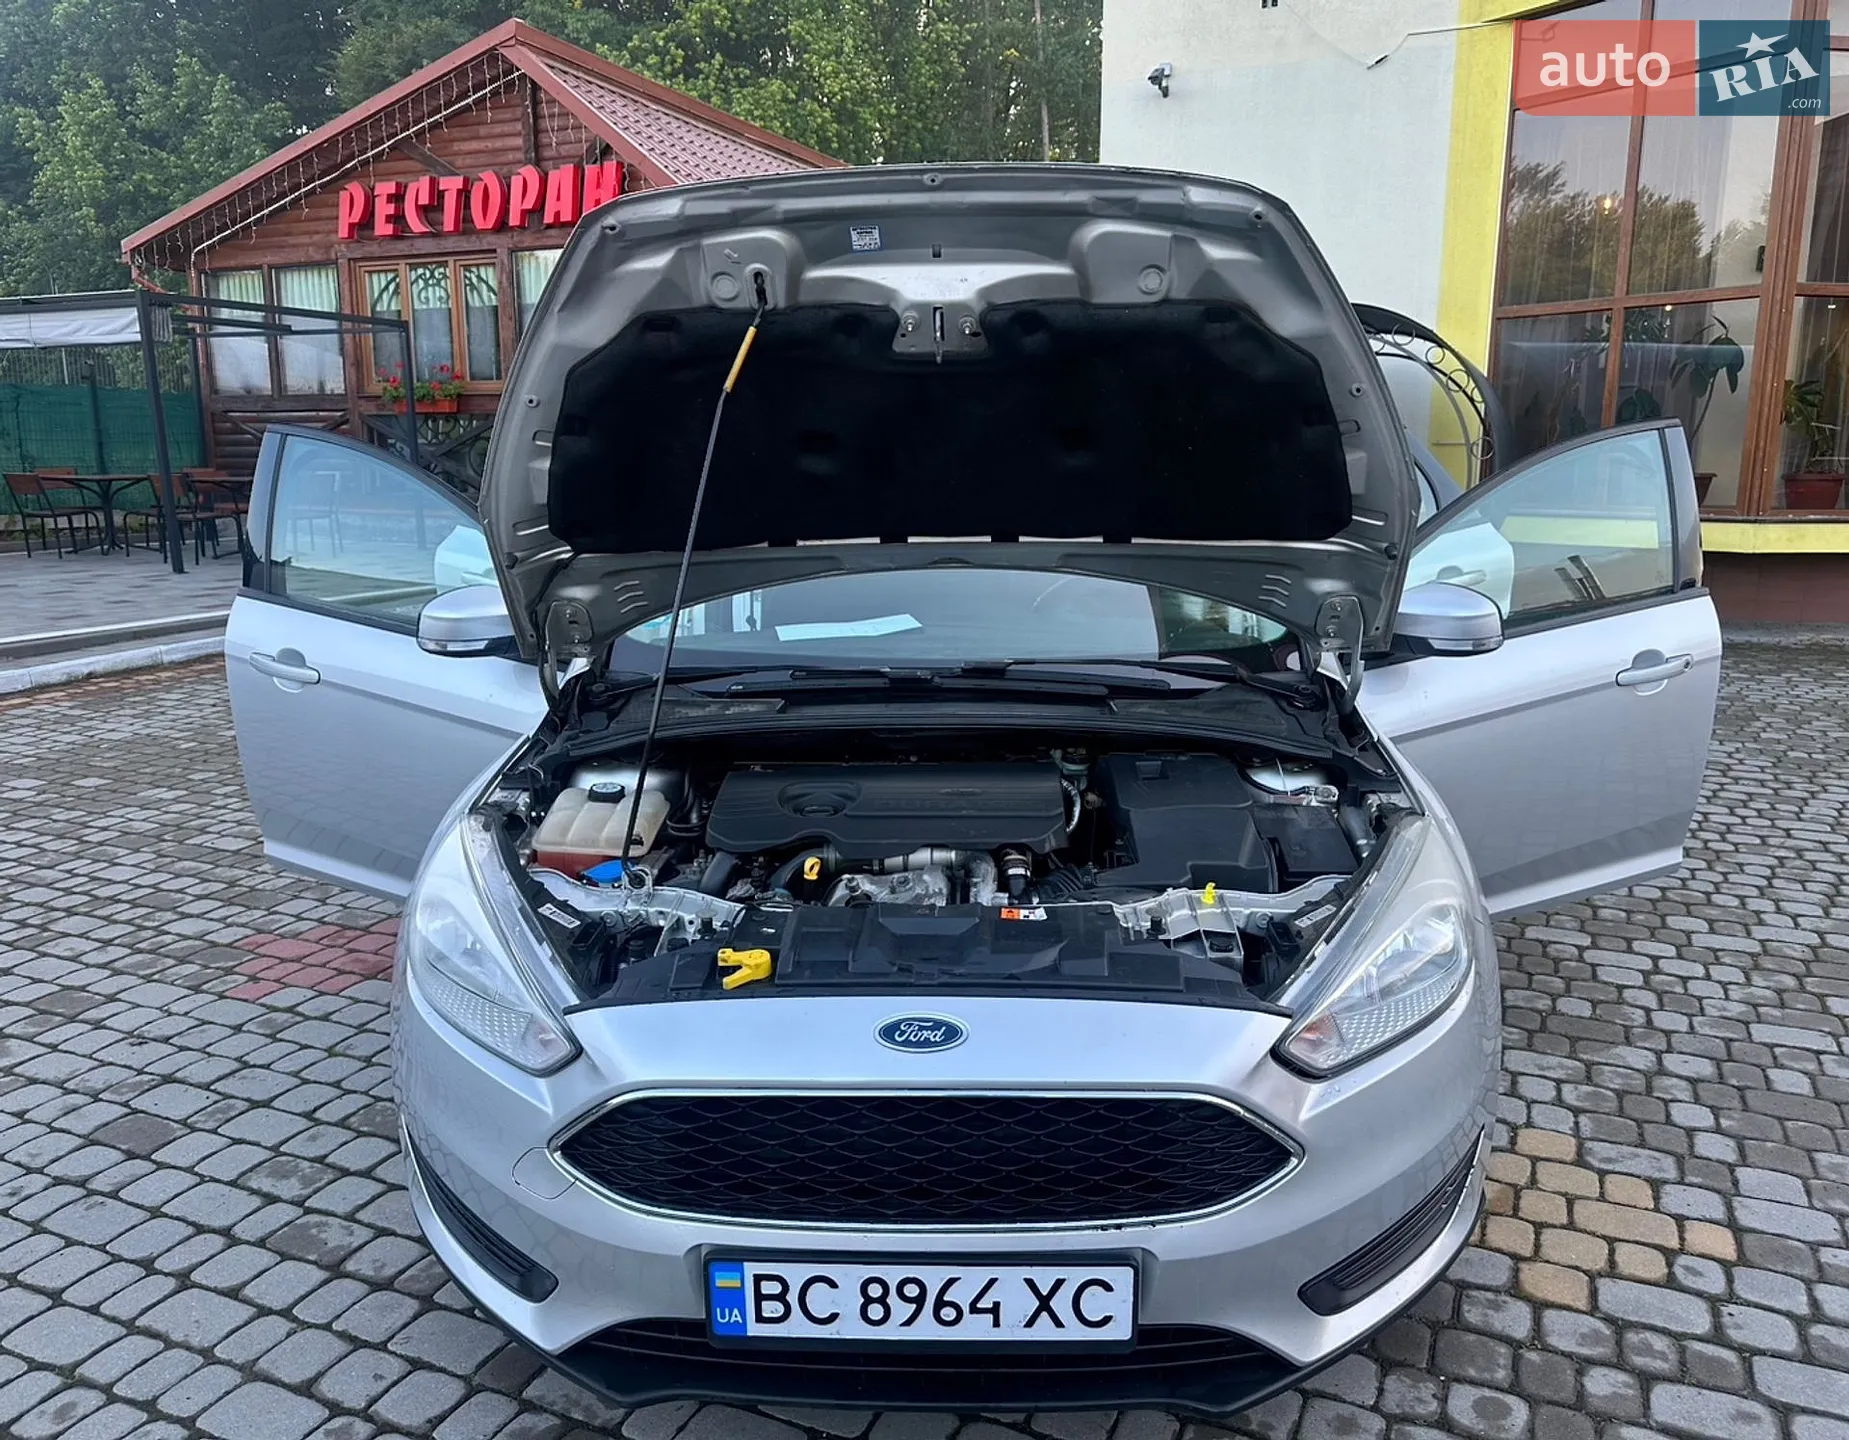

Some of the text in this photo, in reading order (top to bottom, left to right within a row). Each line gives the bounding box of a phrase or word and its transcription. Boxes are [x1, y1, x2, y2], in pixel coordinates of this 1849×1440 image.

[338, 160, 624, 240] РЕСТОРАН
[894, 1021, 946, 1042] Ford
[716, 1307, 743, 1325] UA
[752, 1273, 1115, 1329] BC 8964 XC
